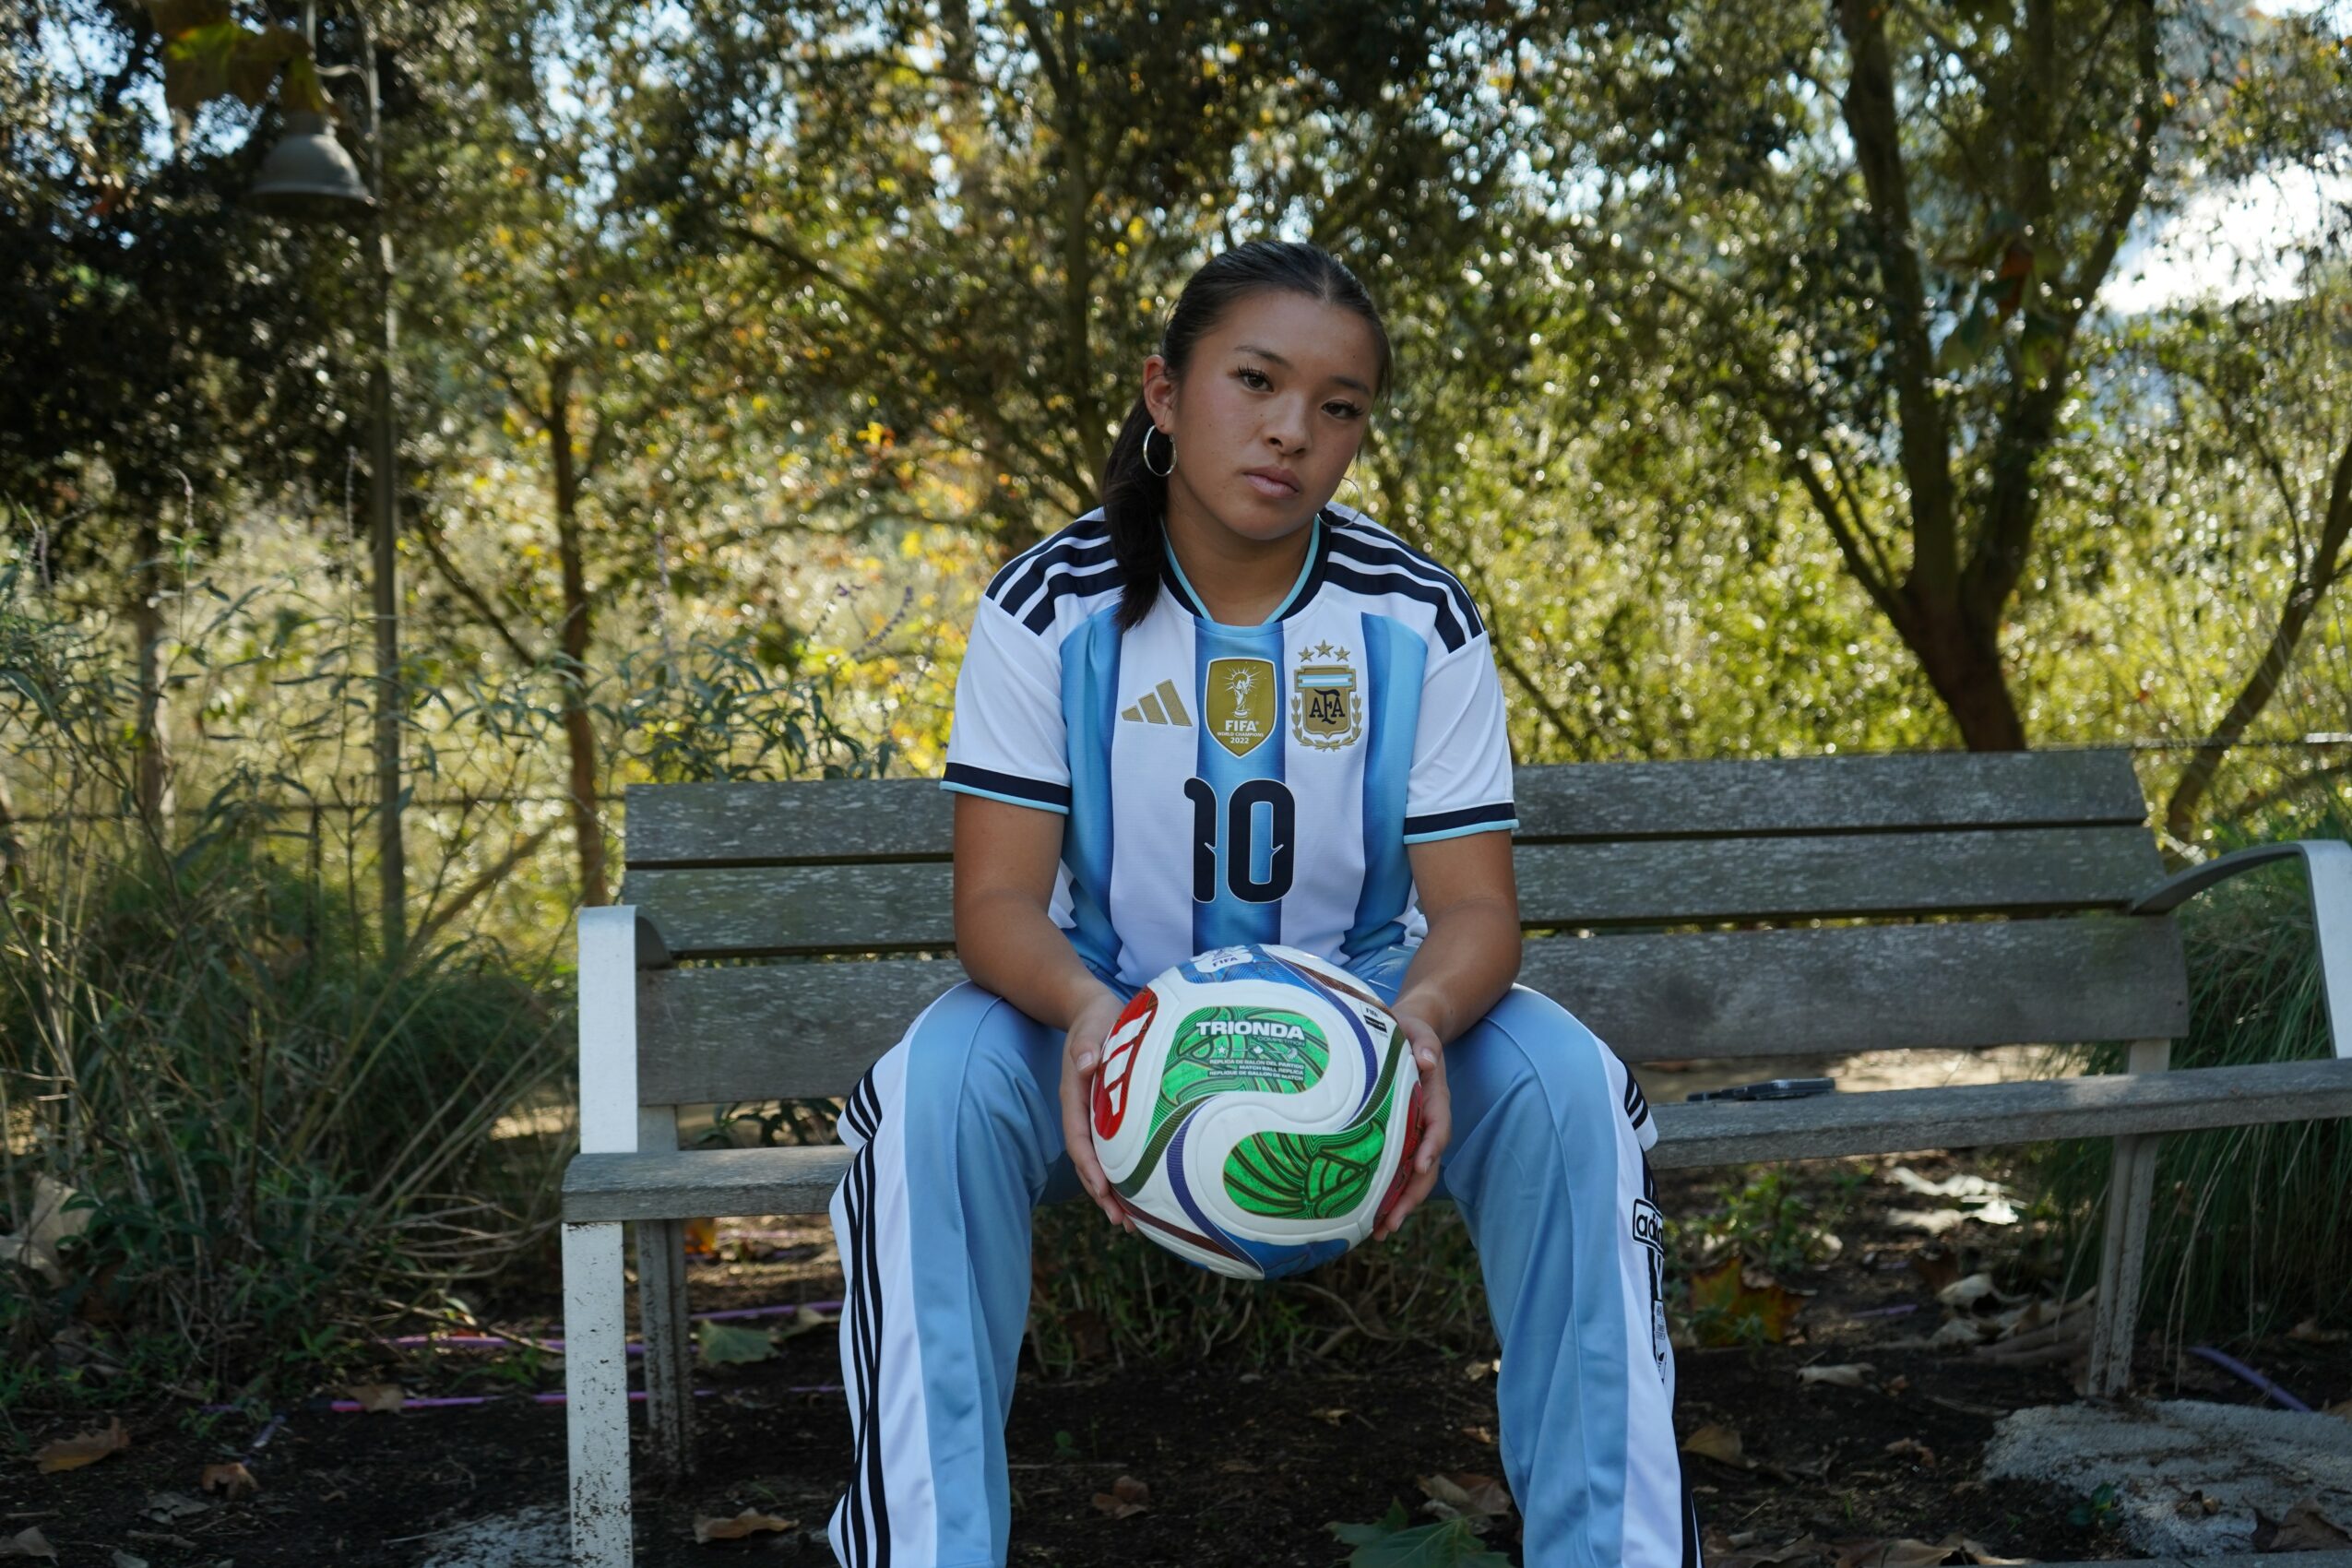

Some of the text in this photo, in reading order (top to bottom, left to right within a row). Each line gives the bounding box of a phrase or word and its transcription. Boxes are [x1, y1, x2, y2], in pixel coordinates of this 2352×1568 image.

[1309, 688, 1346, 724] AFA
[1225, 719, 1257, 732] FIFA
[1183, 777, 1296, 904] 10
[1213, 956, 1238, 967] FIFA
[1195, 1021, 1305, 1039] TRIONDA
[1277, 1062, 1304, 1070] PARTIDO
[1277, 1067, 1304, 1075] REPLICA
